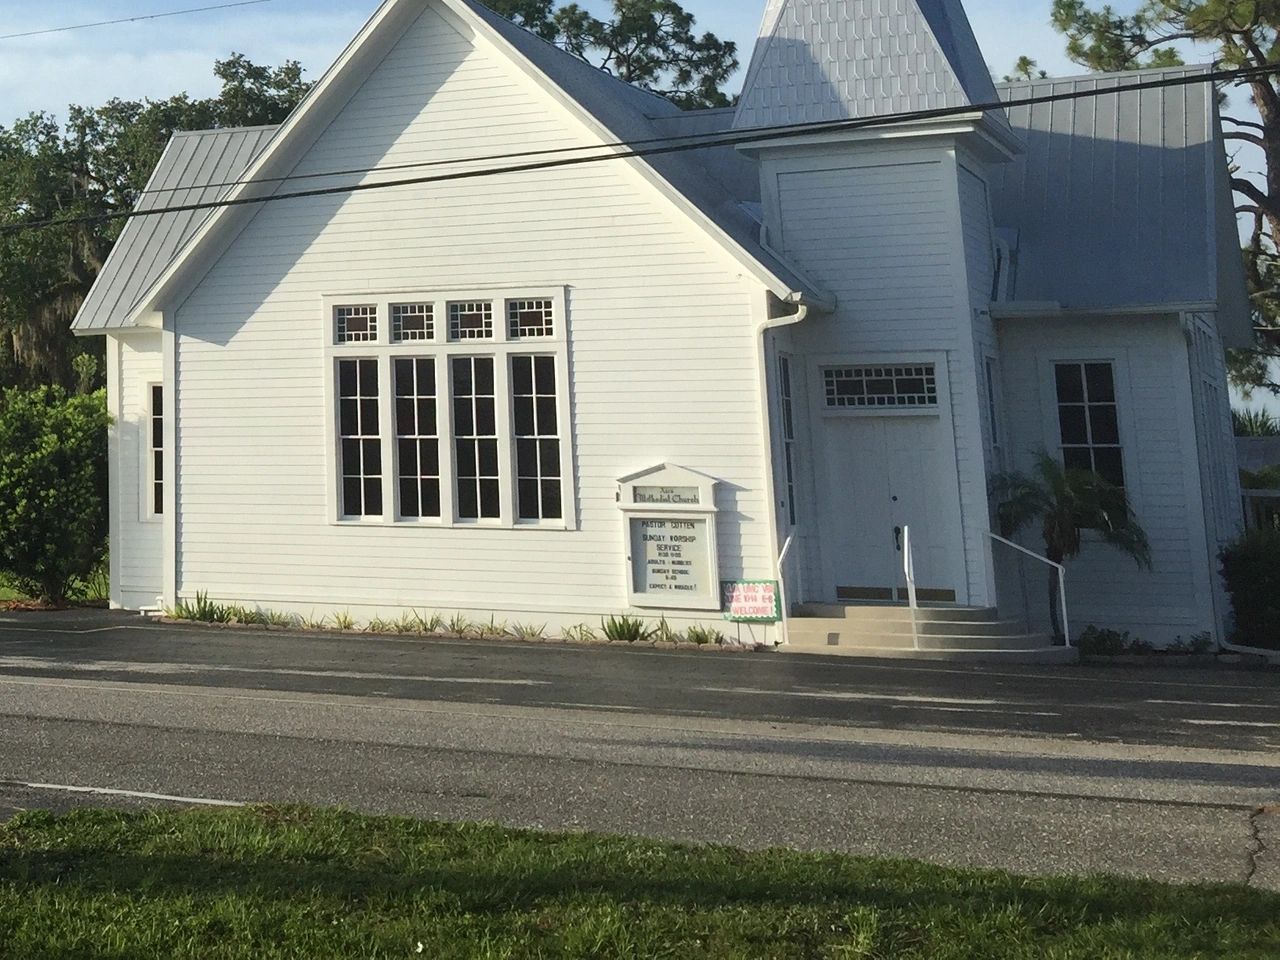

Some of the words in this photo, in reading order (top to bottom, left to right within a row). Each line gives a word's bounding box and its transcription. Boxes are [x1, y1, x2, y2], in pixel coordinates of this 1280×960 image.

[672, 493, 699, 504] Church
[641, 520, 666, 528] PASTOR
[671, 521, 696, 529] COTTEN
[642, 534, 665, 542] SUNDAY
